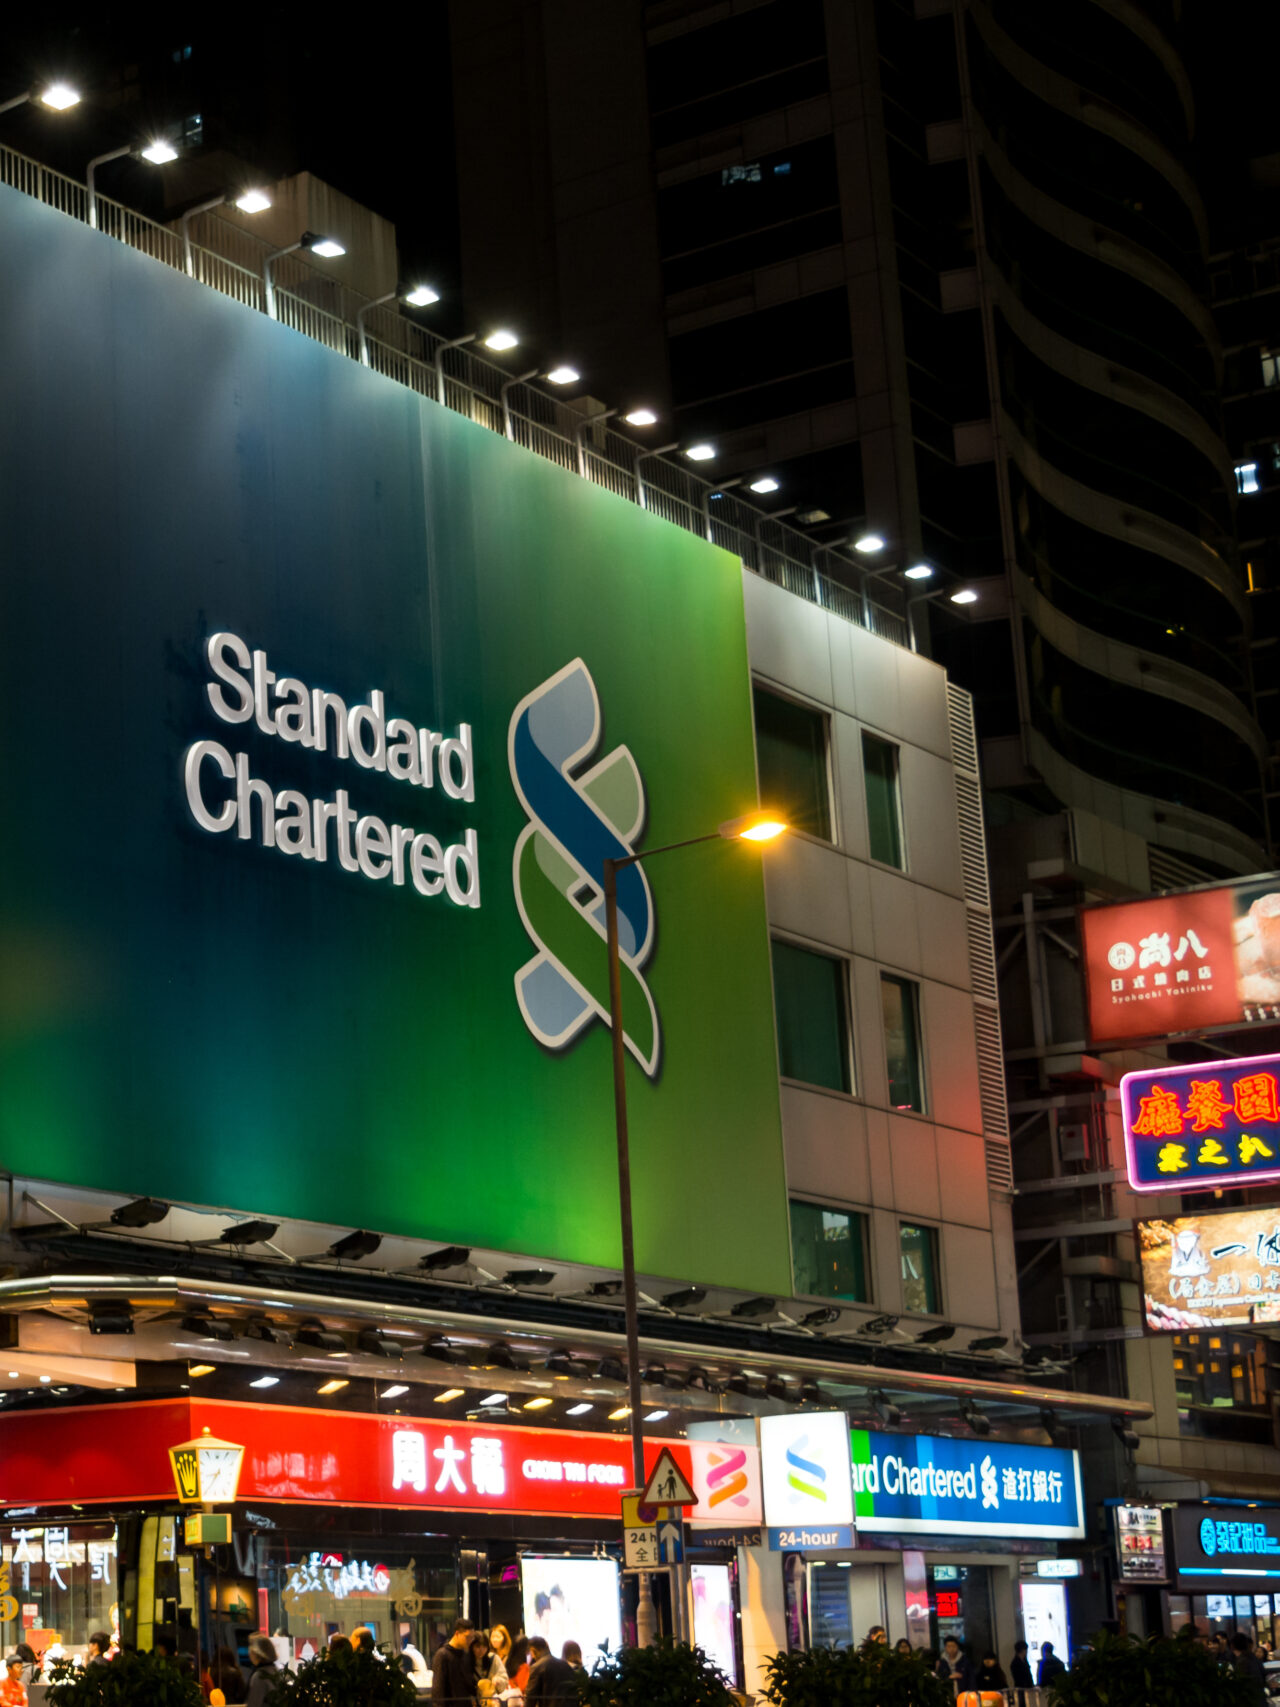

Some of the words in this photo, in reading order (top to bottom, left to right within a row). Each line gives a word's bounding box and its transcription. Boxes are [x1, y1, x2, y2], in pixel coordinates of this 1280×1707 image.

[207, 632, 475, 803] Standard
[184, 740, 481, 909] Chartered
[1139, 929, 1209, 969] 尚八
[1166, 984, 1214, 997] Yakiniku
[392, 1430, 506, 1495] 周大福
[882, 1455, 976, 1500] Chartered
[1002, 1467, 1064, 1504] 渣打銀行
[631, 1532, 647, 1544] 24
[779, 1531, 839, 1547] 24-hour
